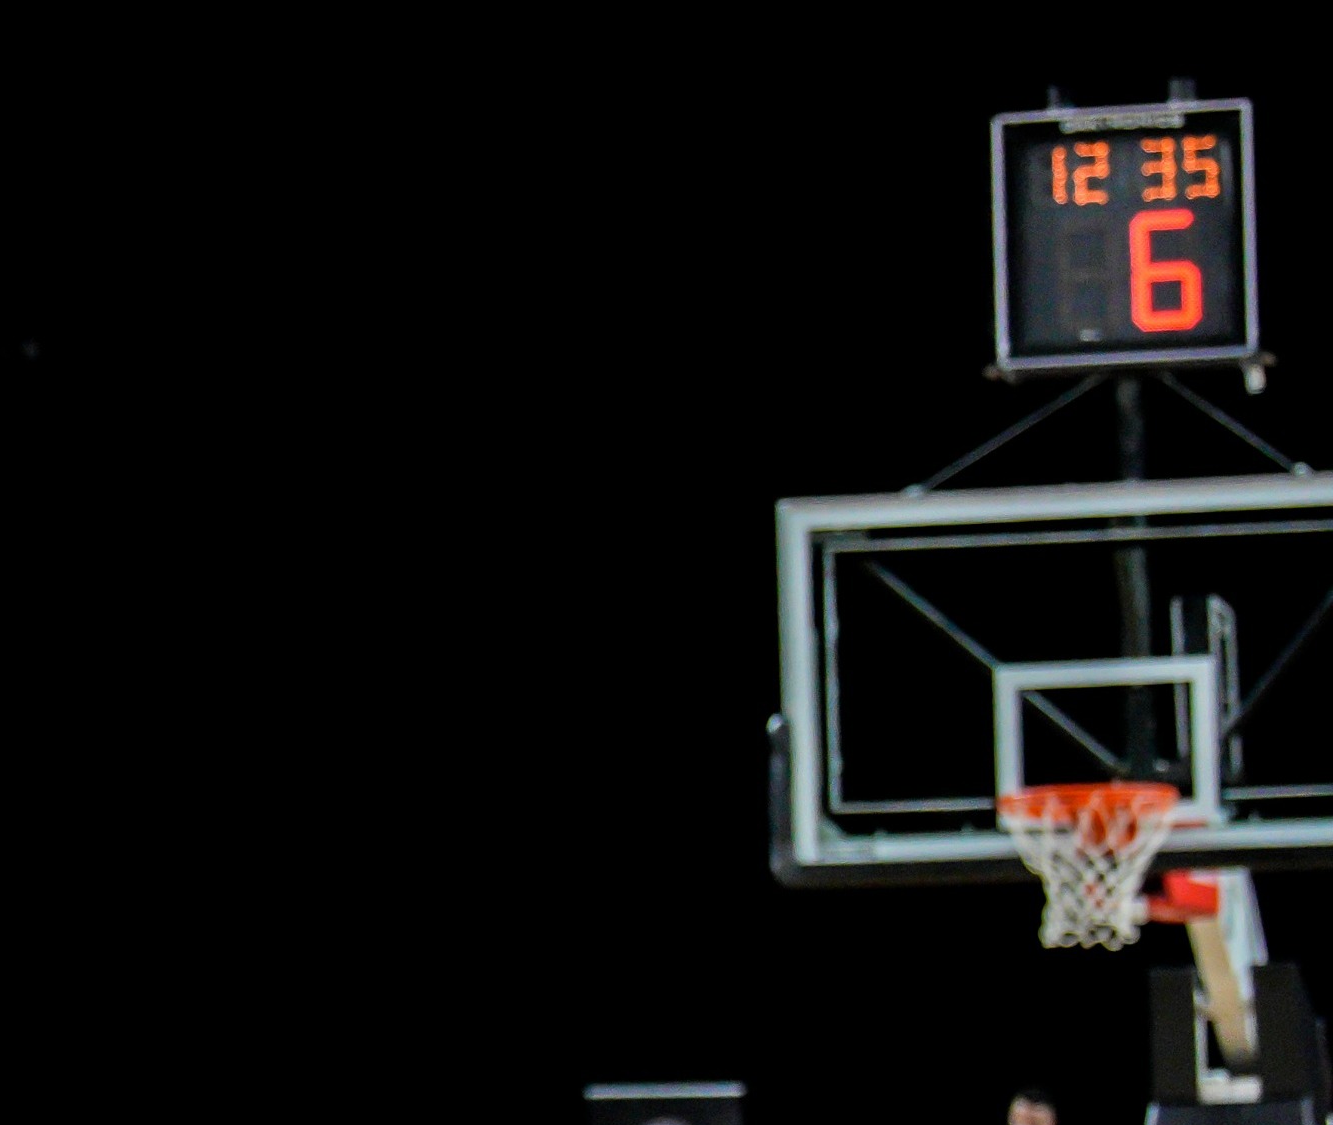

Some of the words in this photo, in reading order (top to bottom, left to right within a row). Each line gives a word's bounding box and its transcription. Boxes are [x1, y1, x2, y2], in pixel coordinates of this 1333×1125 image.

[1051, 141, 1110, 206] 12
[1140, 134, 1221, 203] 35
[1129, 209, 1203, 332] 6
